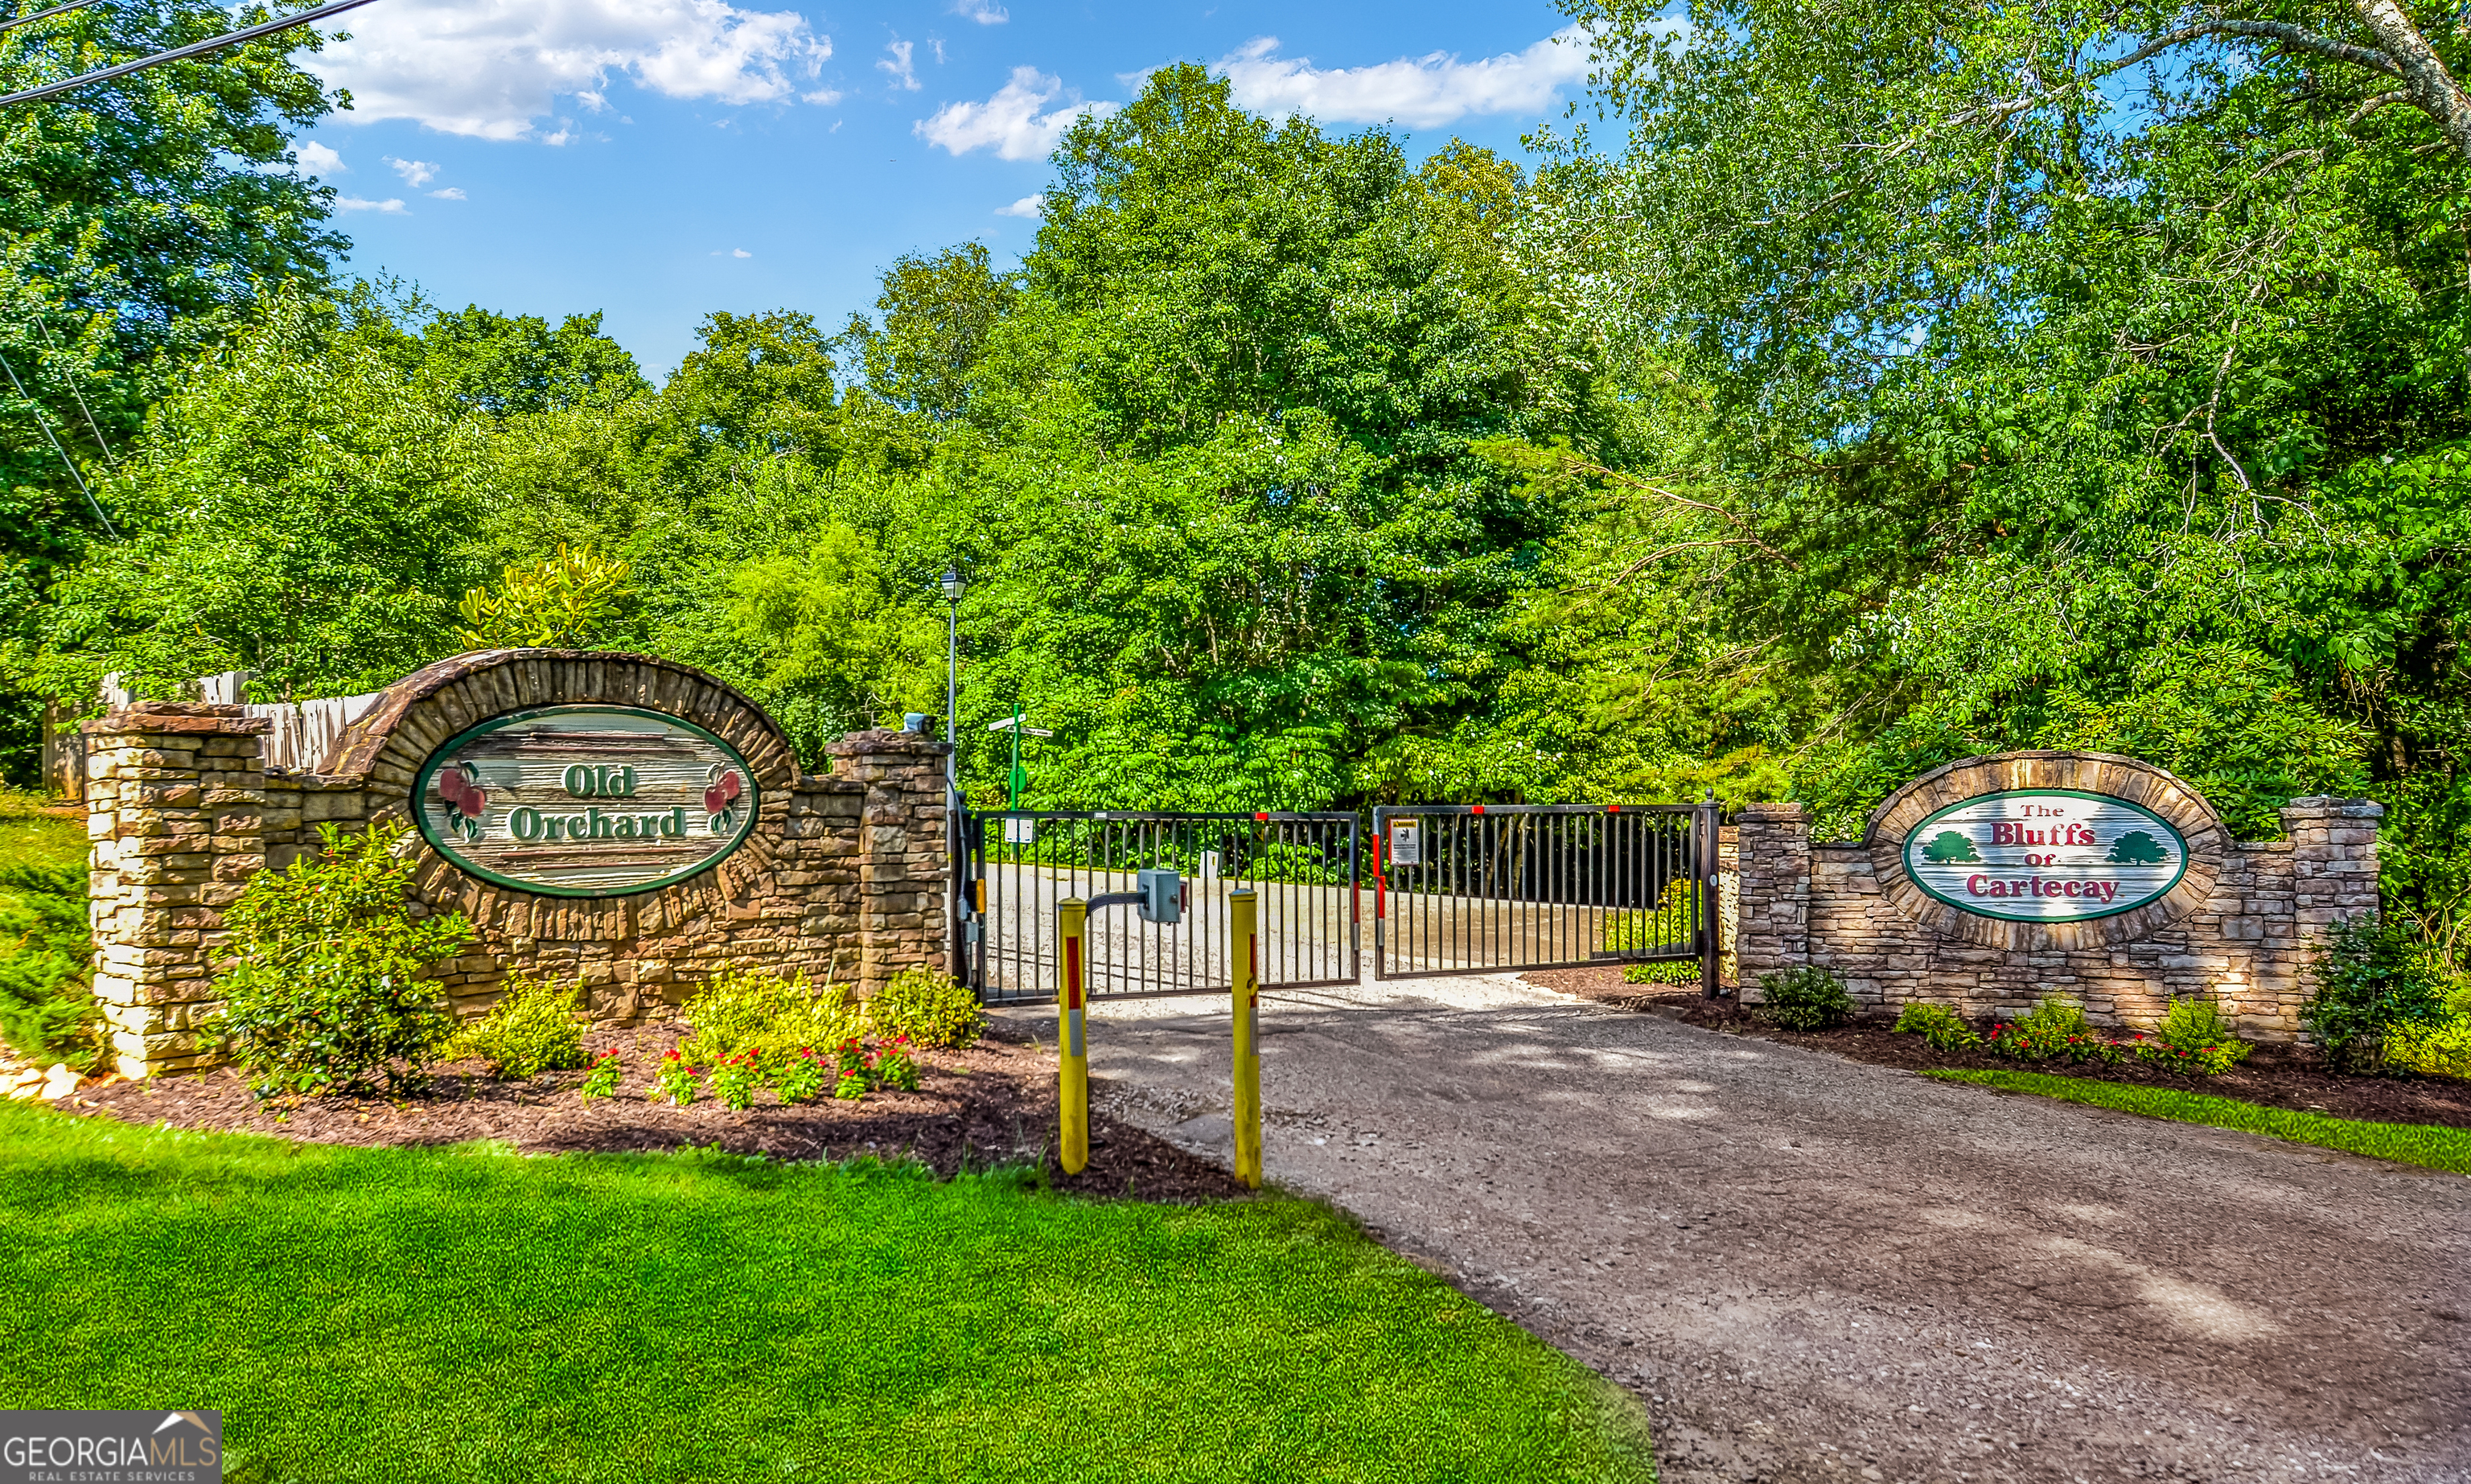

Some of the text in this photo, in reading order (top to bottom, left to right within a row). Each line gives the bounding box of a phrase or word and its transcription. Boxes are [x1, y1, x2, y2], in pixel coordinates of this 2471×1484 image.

[564, 763, 635, 798] Old
[510, 806, 685, 841] Orchard
[2021, 804, 2065, 817] The
[1989, 822, 2096, 845] Bluffs
[1967, 874, 2120, 904] Cartecay
